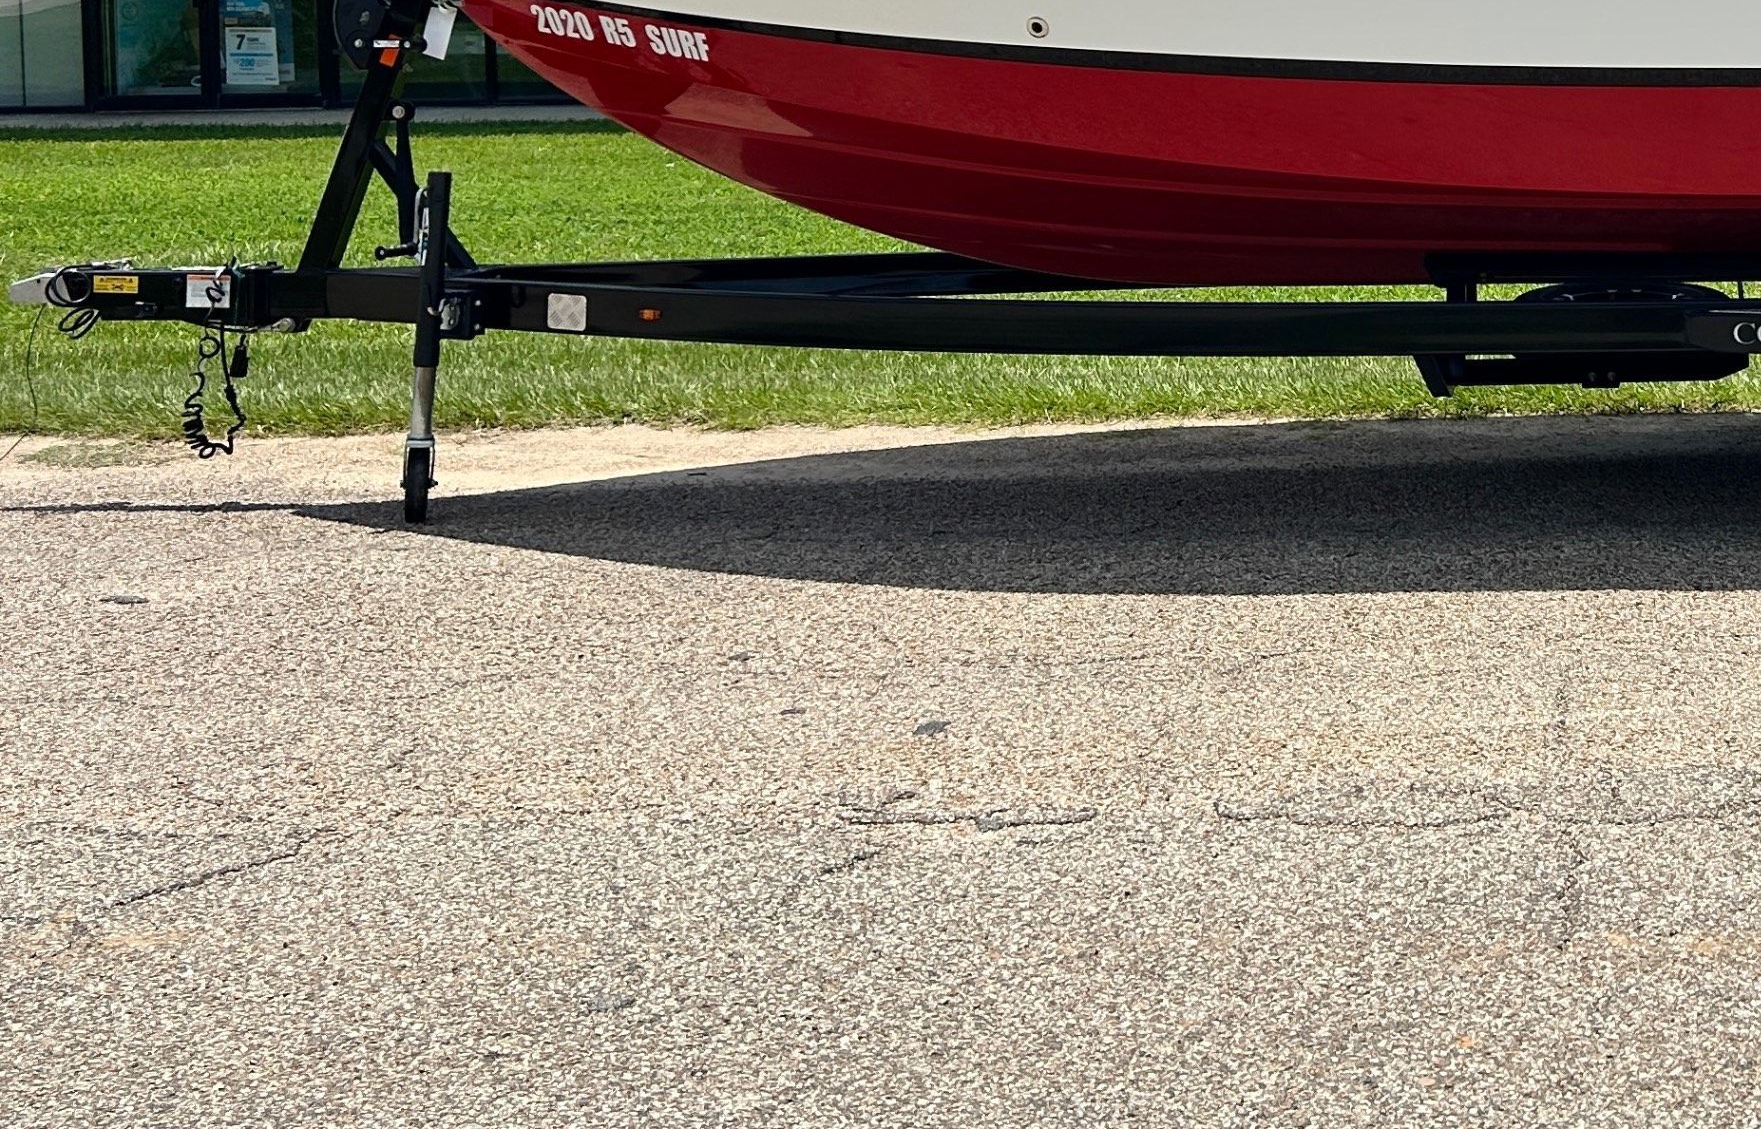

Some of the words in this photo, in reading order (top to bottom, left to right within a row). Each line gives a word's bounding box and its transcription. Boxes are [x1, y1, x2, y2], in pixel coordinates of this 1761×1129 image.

[236, 33, 246, 50] 7
[530, 4, 594, 42] 2020
[598, 15, 637, 48] R5
[644, 24, 709, 62] SURF
